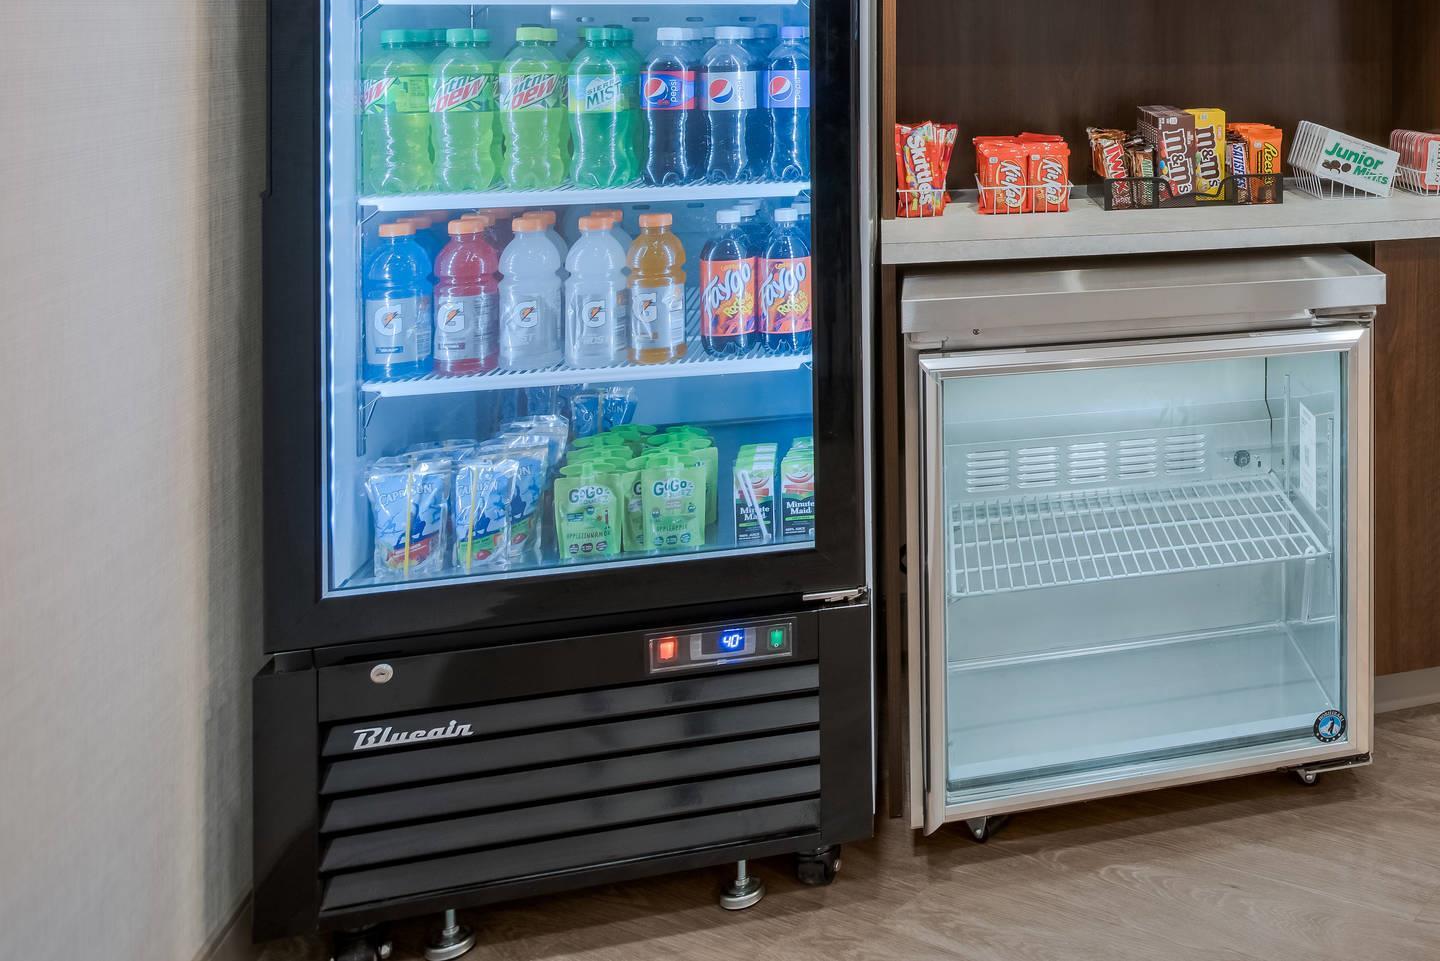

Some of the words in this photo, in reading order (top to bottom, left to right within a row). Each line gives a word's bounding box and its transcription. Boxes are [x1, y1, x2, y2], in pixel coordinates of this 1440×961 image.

[669, 79, 678, 103] pepsi
[1324, 142, 1384, 171] Junior
[1353, 165, 1389, 186] Mints
[702, 262, 751, 319] Faygo
[761, 262, 806, 317] Faygo
[352, 719, 475, 751] Blueair
